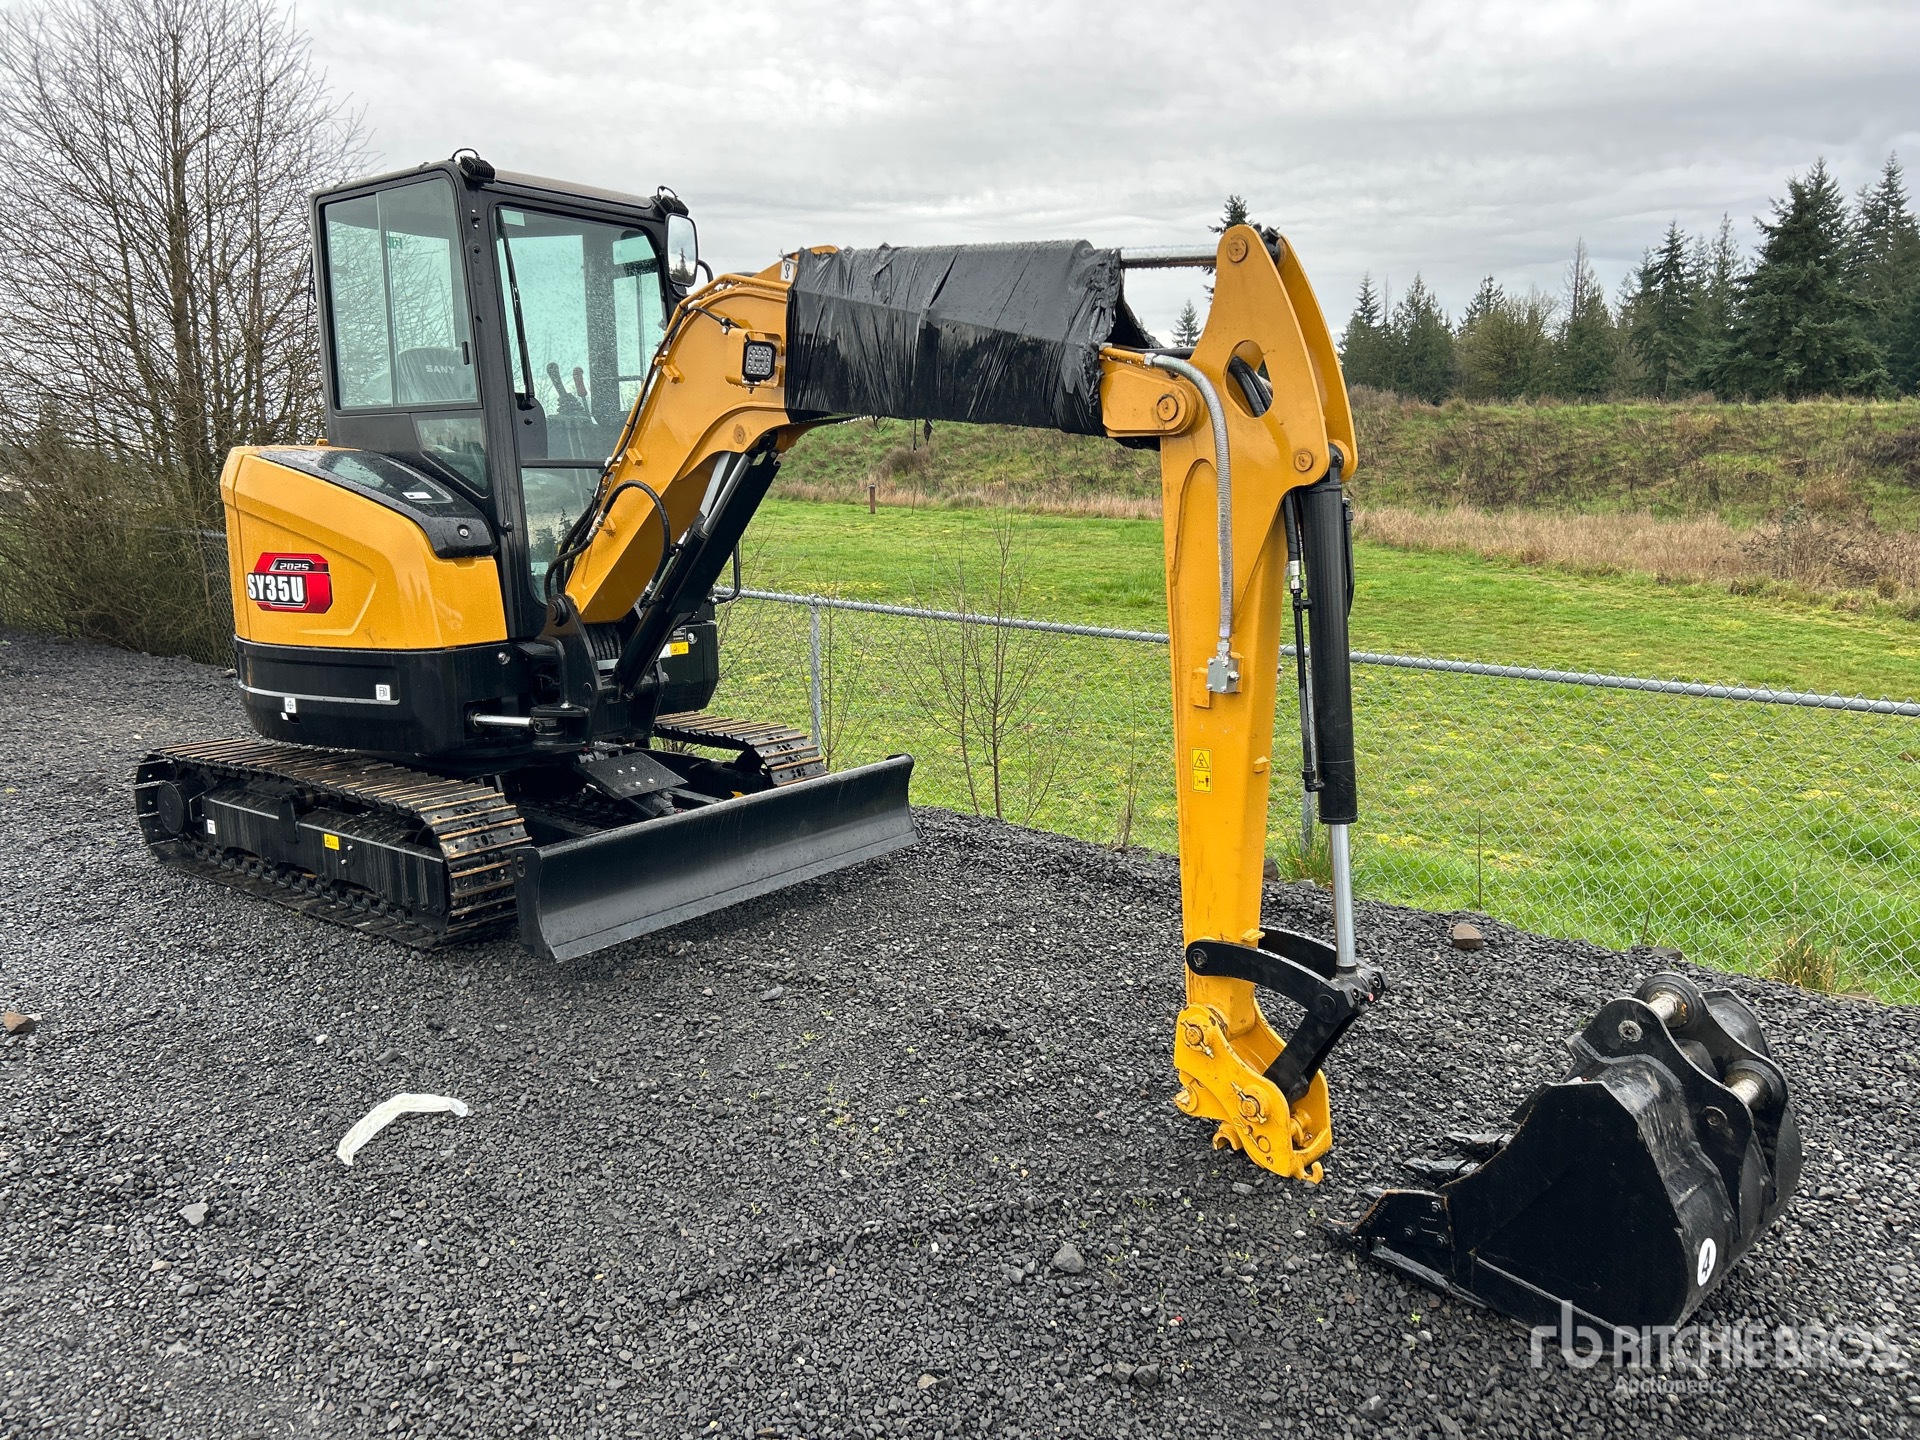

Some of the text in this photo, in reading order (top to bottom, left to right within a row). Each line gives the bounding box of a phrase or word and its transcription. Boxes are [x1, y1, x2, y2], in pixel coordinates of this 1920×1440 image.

[425, 364, 455, 374] SANY
[279, 562, 309, 571] 2025
[247, 574, 304, 602] SY35U
